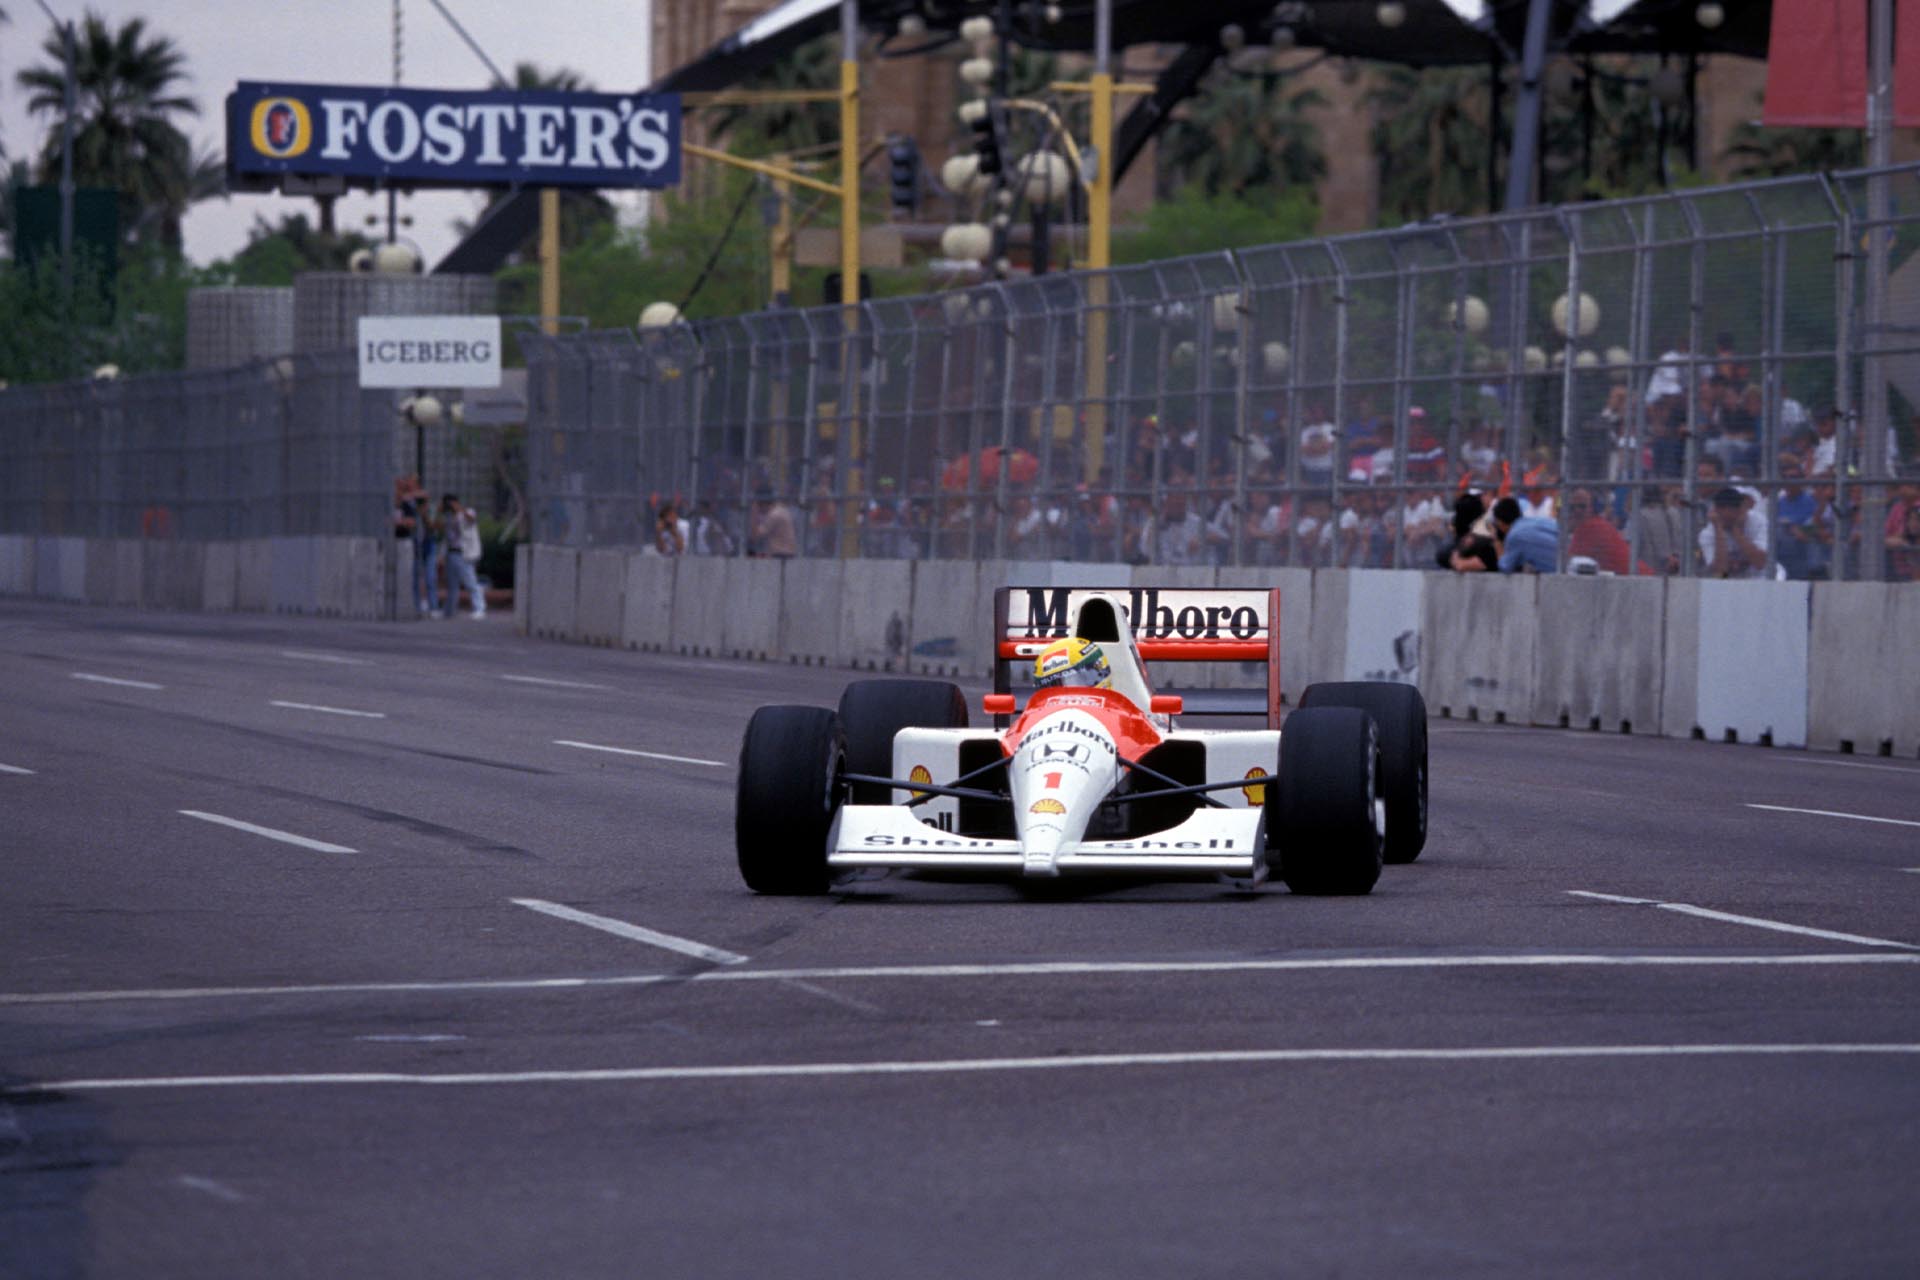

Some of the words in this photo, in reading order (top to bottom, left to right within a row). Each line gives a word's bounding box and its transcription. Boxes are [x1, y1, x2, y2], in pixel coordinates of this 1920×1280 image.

[320, 99, 670, 170] FOSTER'S
[366, 340, 491, 363] ICEBERG
[1025, 588, 1259, 640] Mlboro
[1043, 771, 1062, 789] 1
